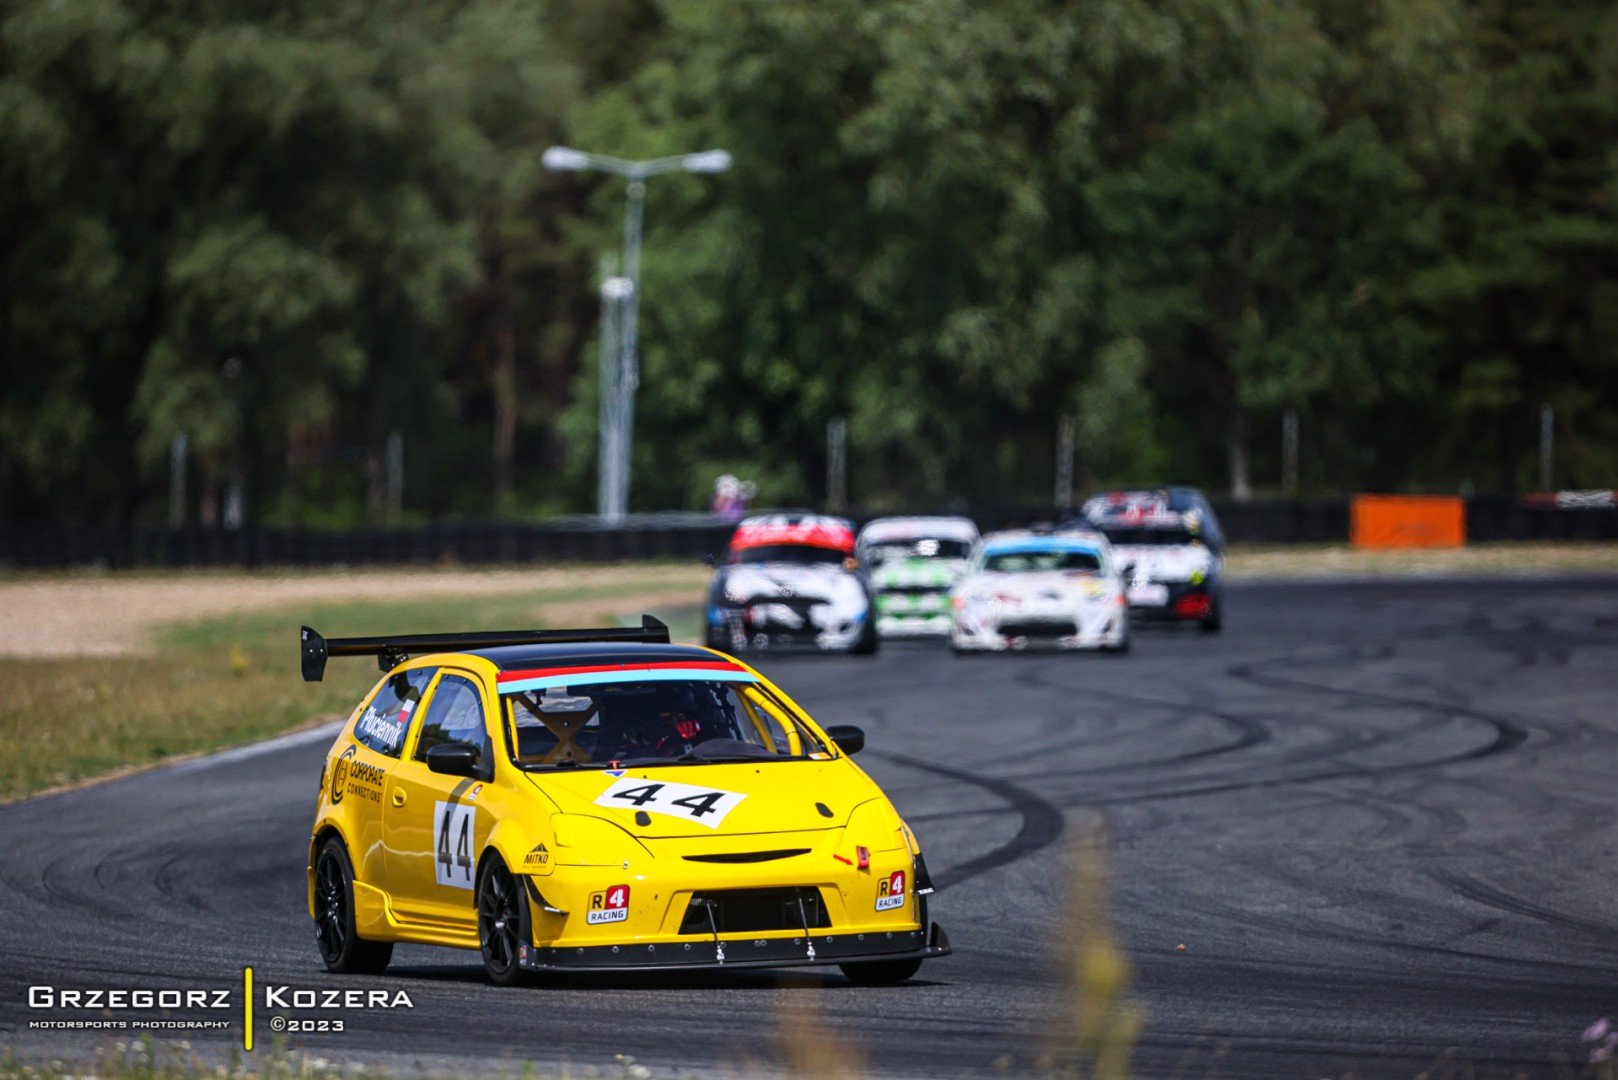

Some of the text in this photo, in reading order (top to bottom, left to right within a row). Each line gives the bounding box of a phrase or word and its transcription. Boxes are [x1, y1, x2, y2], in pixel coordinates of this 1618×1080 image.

[350, 760, 386, 787] CORPORATE
[347, 782, 381, 803] CONNECTIONS
[611, 783, 726, 817] 44
[438, 810, 471, 881] 44
[523, 853, 549, 864] MITKO
[878, 897, 902, 908] RACING
[591, 910, 624, 920] RACING
